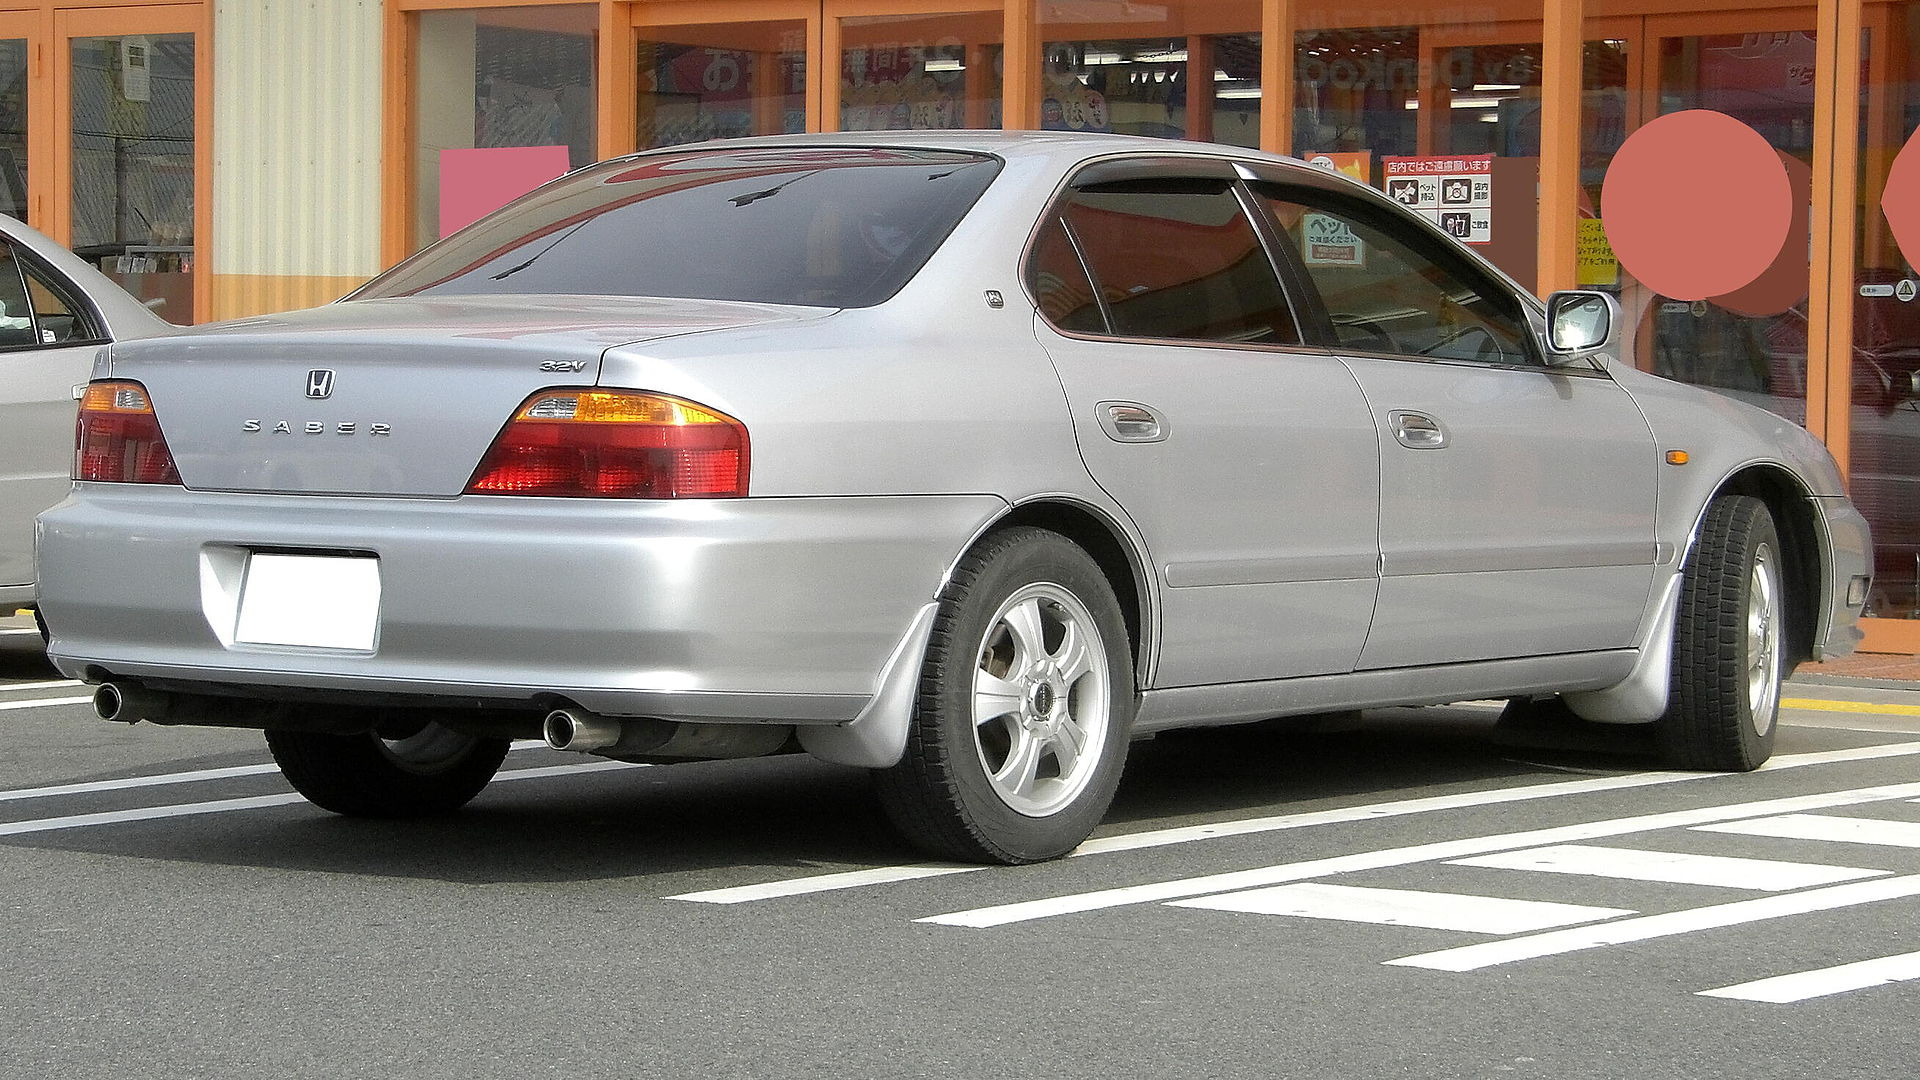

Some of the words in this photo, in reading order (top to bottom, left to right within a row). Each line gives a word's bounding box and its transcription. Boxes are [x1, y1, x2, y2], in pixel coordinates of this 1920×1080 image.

[1387, 160, 1491, 172] 店内ではご遠慮願います
[243, 419, 391, 436] SABER
